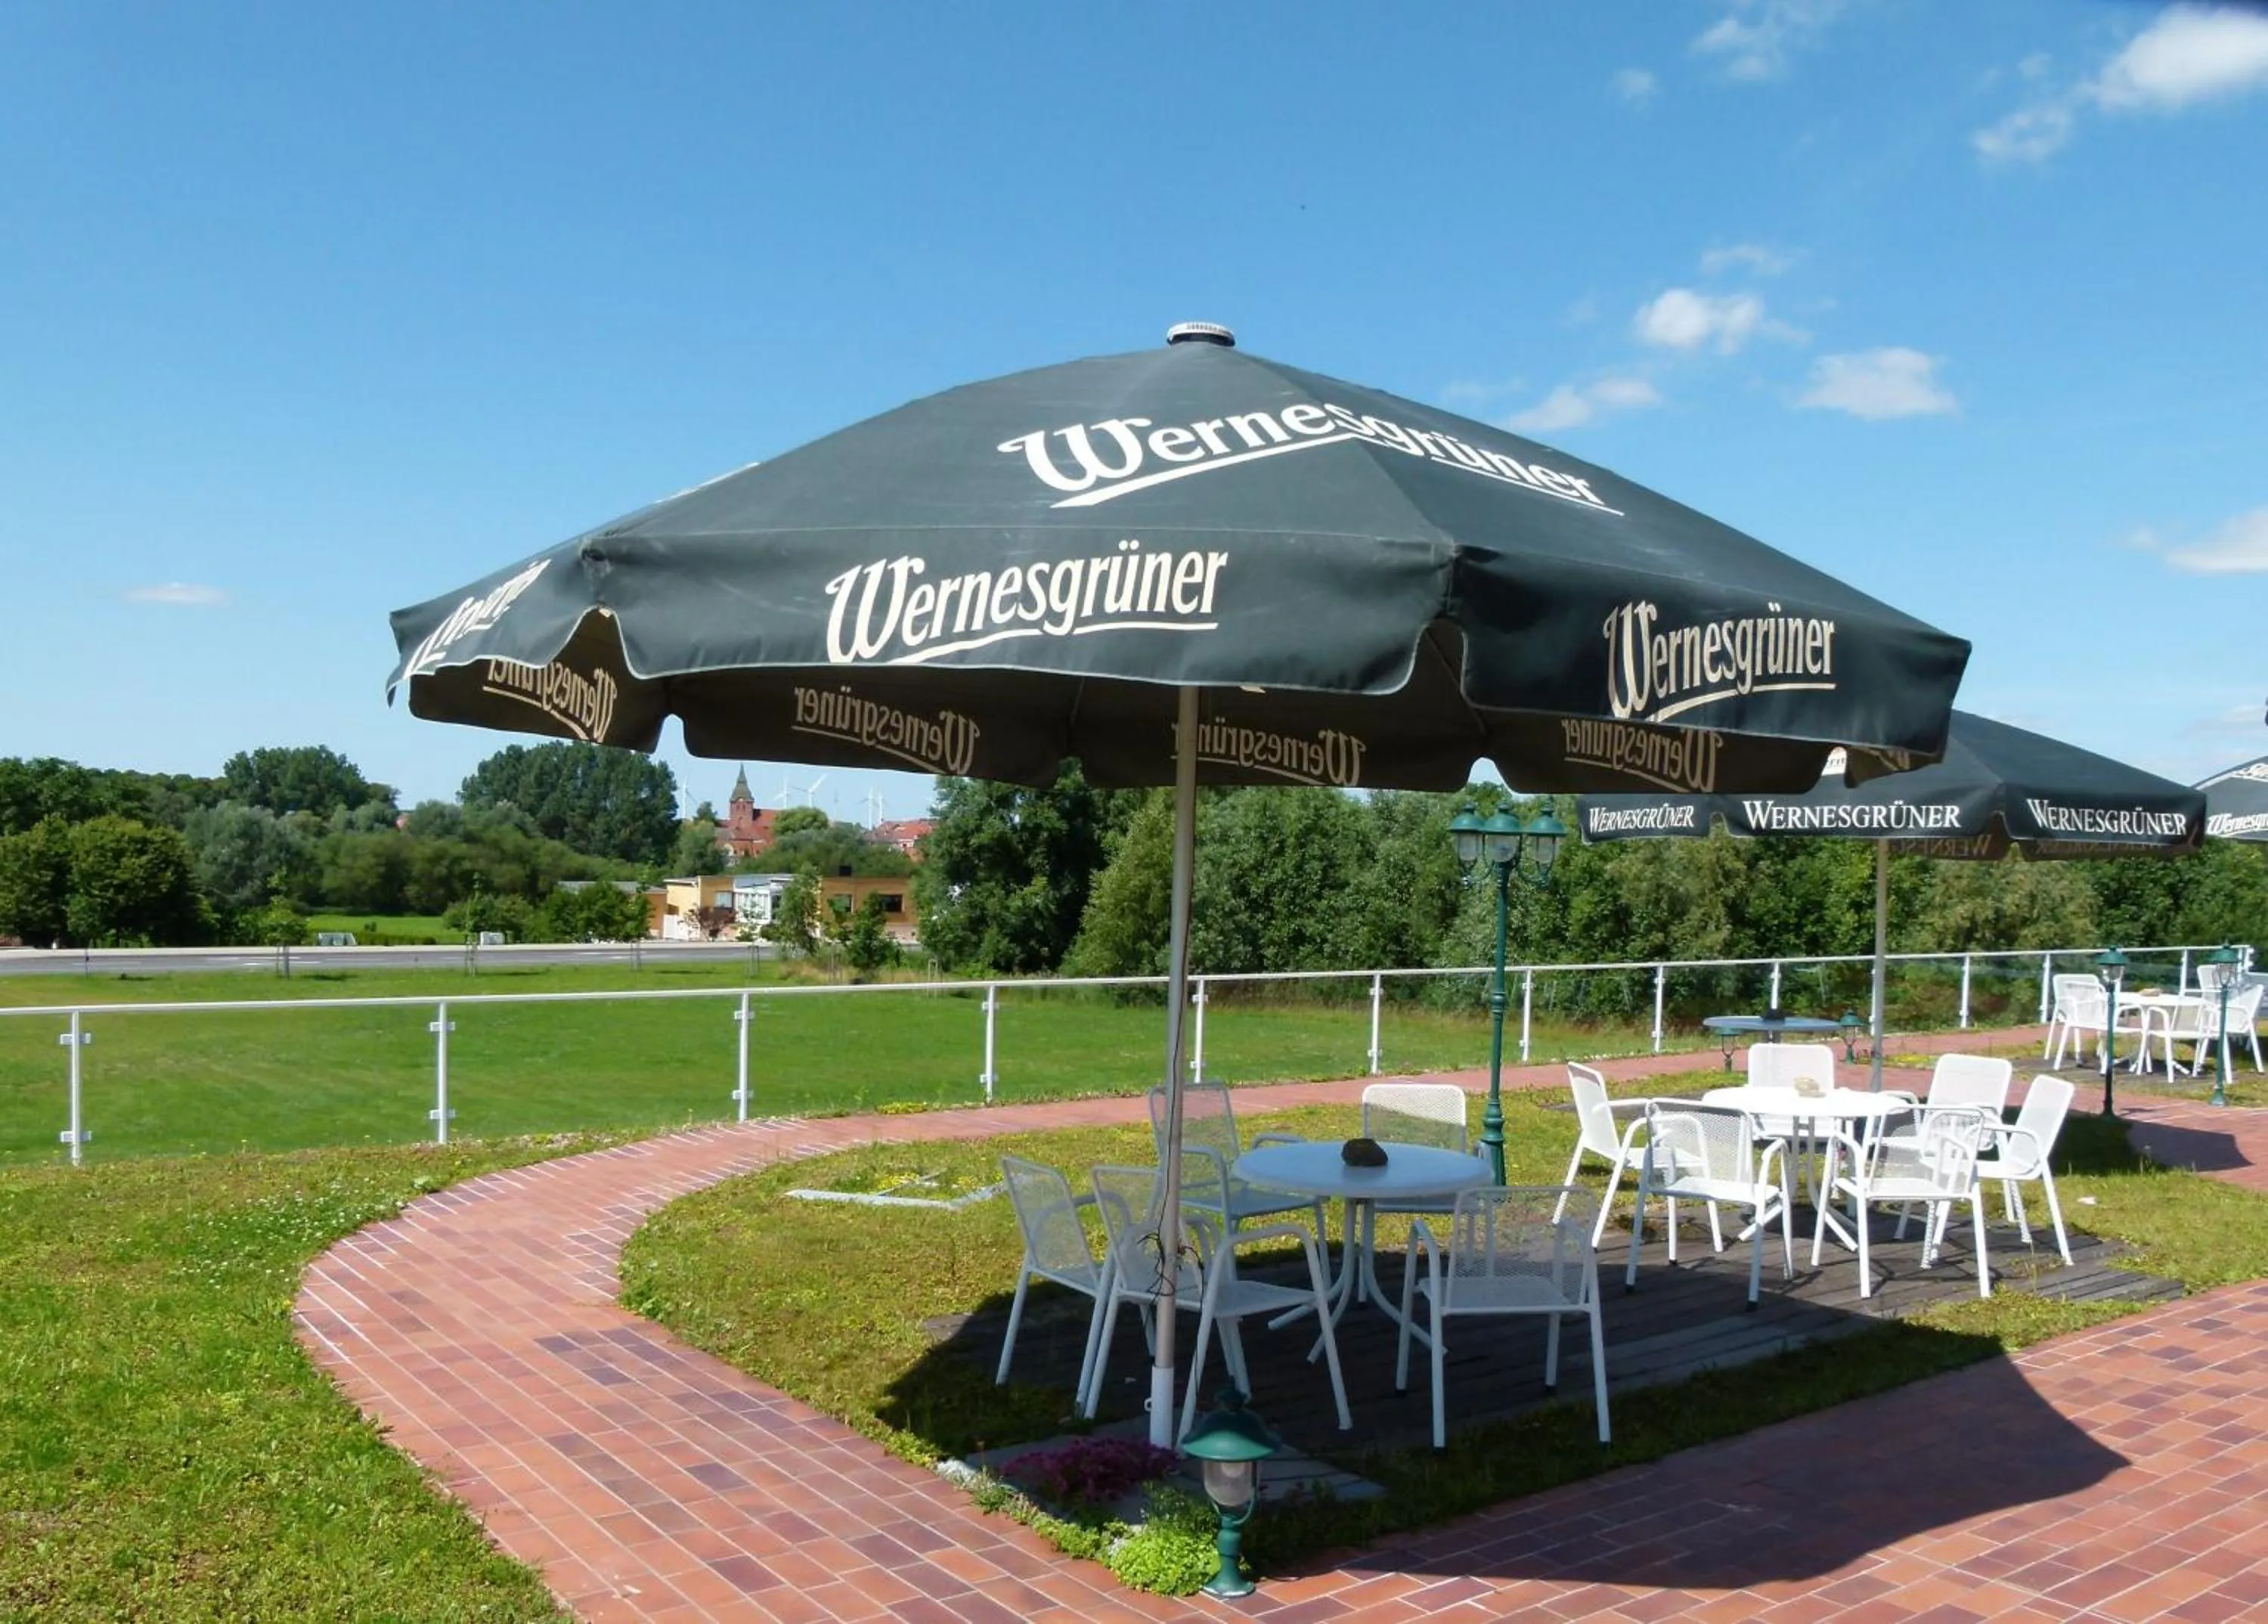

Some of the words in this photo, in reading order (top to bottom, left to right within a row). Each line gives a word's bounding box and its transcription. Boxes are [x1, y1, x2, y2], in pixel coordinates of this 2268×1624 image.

[997, 402, 1604, 505] Wernesgrüner
[825, 539, 1228, 664] Wernesgrüner
[1603, 600, 1836, 720] Wernesgrüner
[1742, 799, 1962, 830] WERNESGRÜNER
